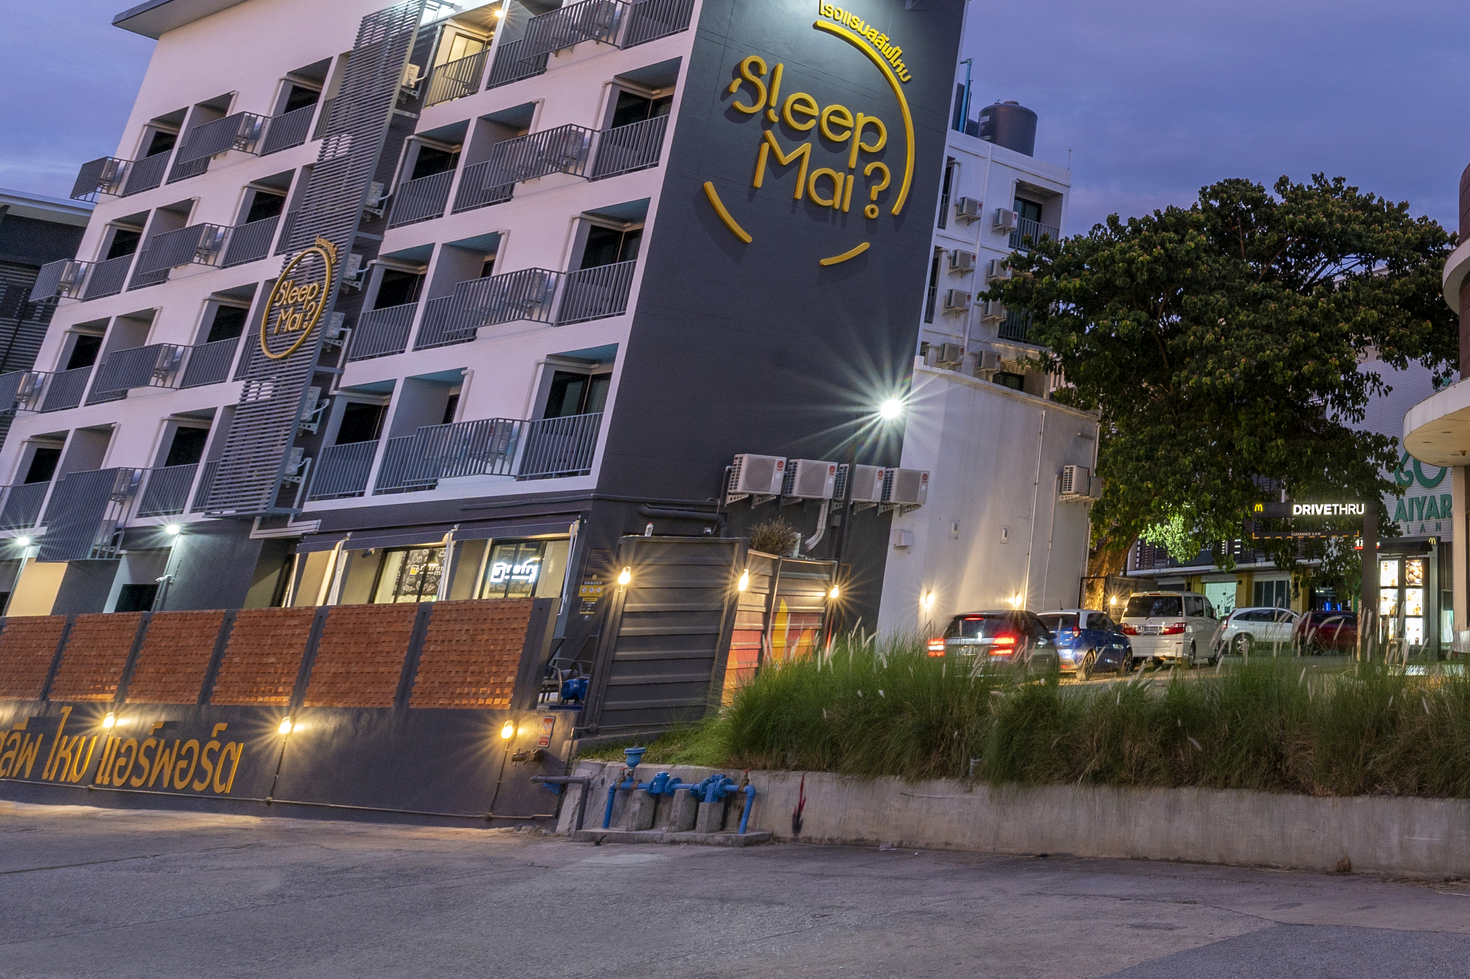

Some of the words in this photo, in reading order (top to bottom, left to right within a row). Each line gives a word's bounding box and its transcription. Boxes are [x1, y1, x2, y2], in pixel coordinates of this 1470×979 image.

[1292, 503, 1365, 516] DRIVETHRU
[1407, 520, 1453, 534] LAN
[42, 705, 98, 784] ไหม
[95, 721, 244, 795] แอร์พอร์ต
